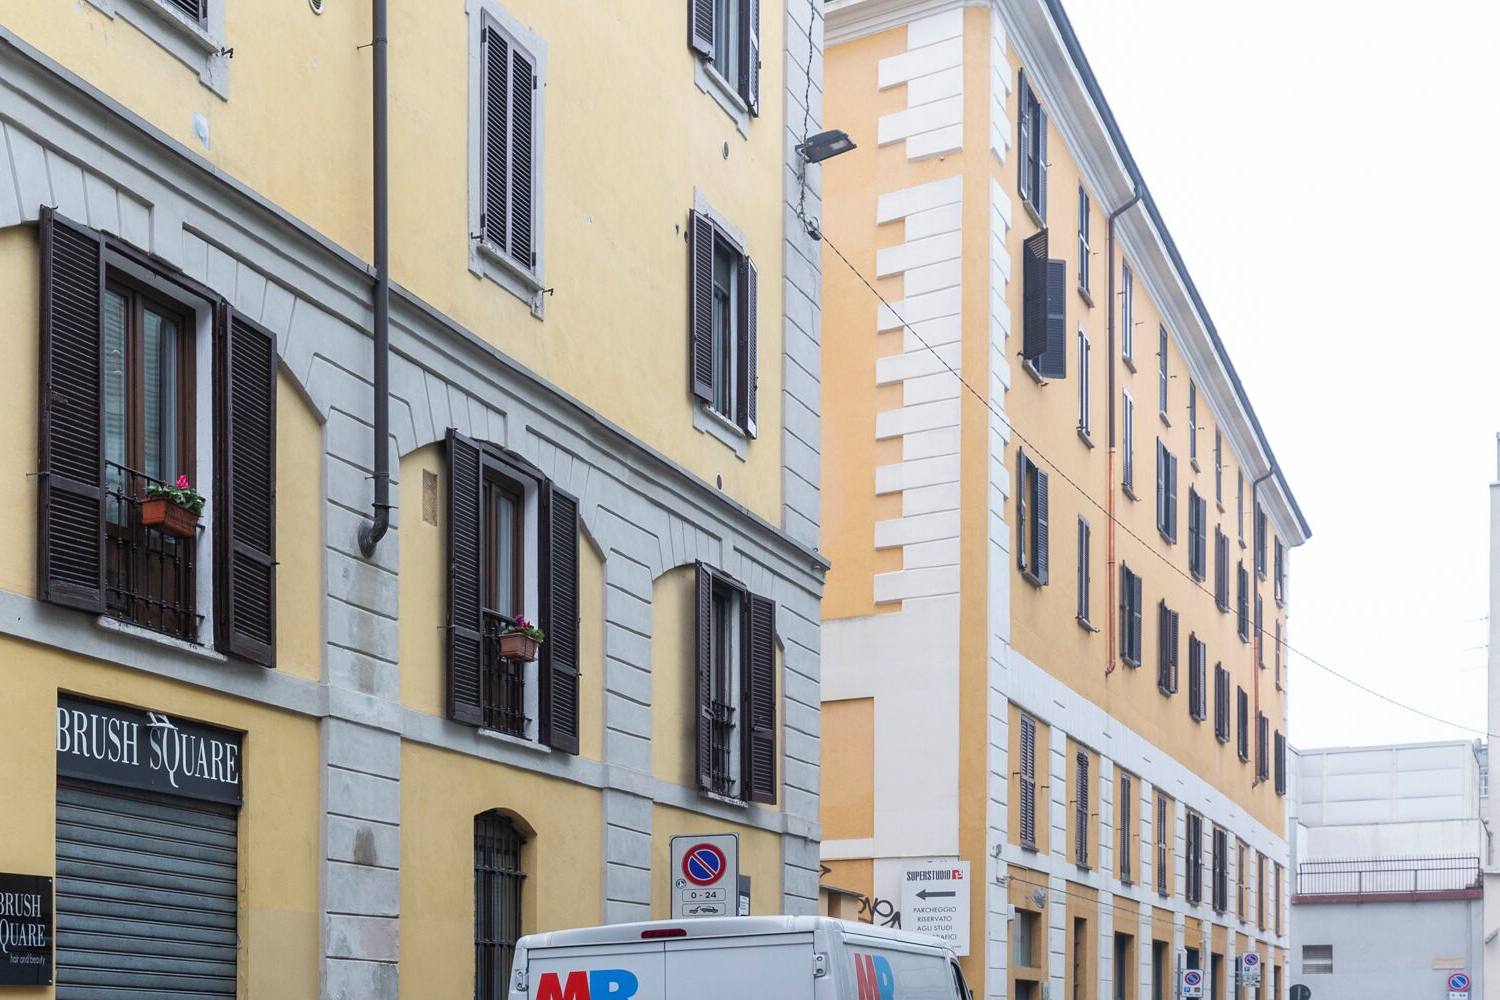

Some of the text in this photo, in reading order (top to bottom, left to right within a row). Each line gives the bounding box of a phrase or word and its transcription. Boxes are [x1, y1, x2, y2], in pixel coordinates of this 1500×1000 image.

[56, 706, 239, 788] BRUSH SQUARE
[907, 870, 951, 881] SUPERSTUDIO
[10, 953, 45, 966] hair and beauty
